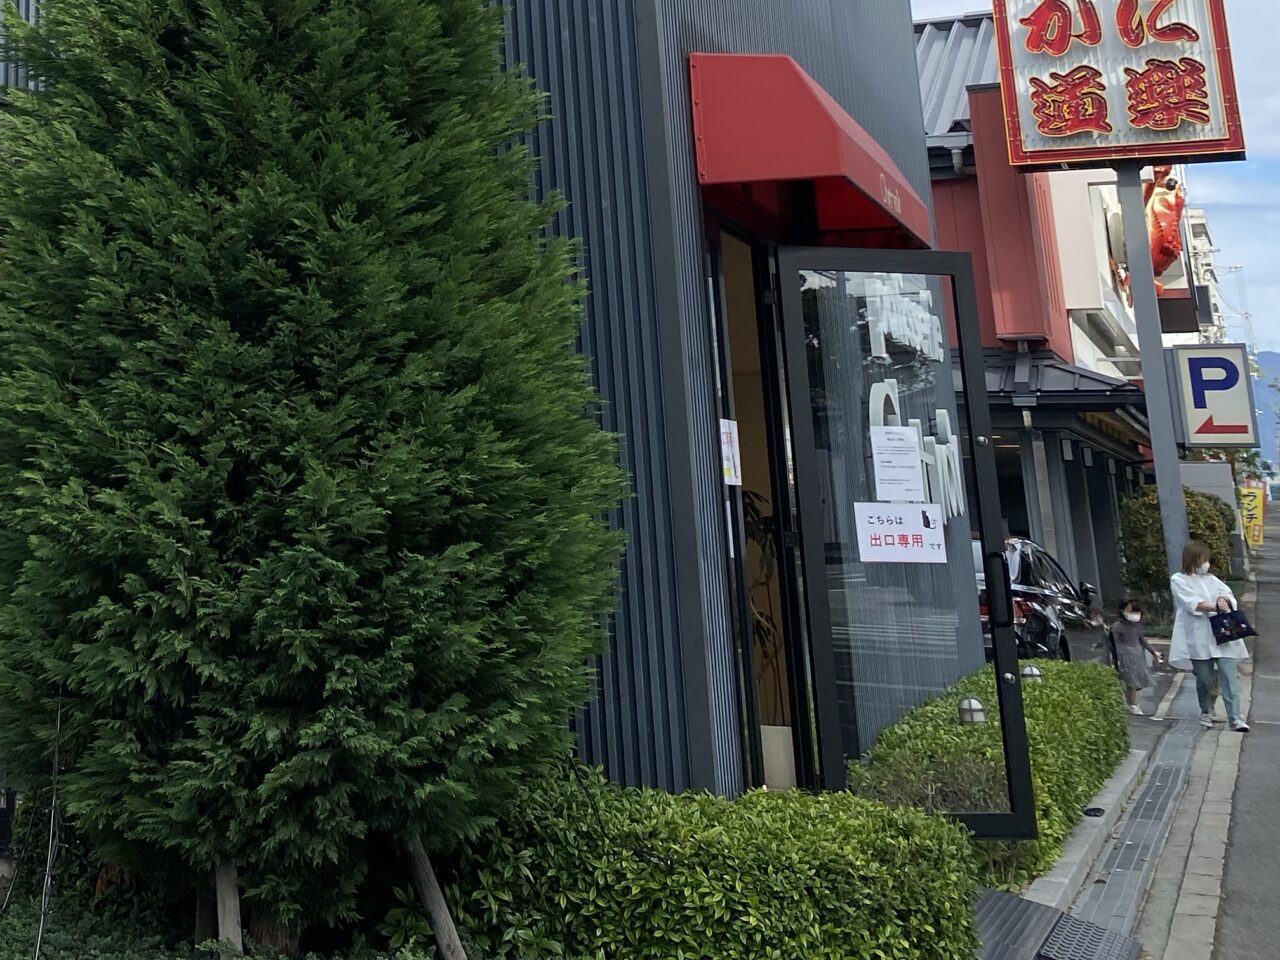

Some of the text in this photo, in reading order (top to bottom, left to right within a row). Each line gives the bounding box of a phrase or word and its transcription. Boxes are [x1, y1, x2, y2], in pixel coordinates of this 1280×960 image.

[1187, 357, 1240, 409] P
[1243, 491, 1258, 523] ランチ
[867, 515, 904, 525] こちらは
[870, 533, 942, 550] 出口専用 です
